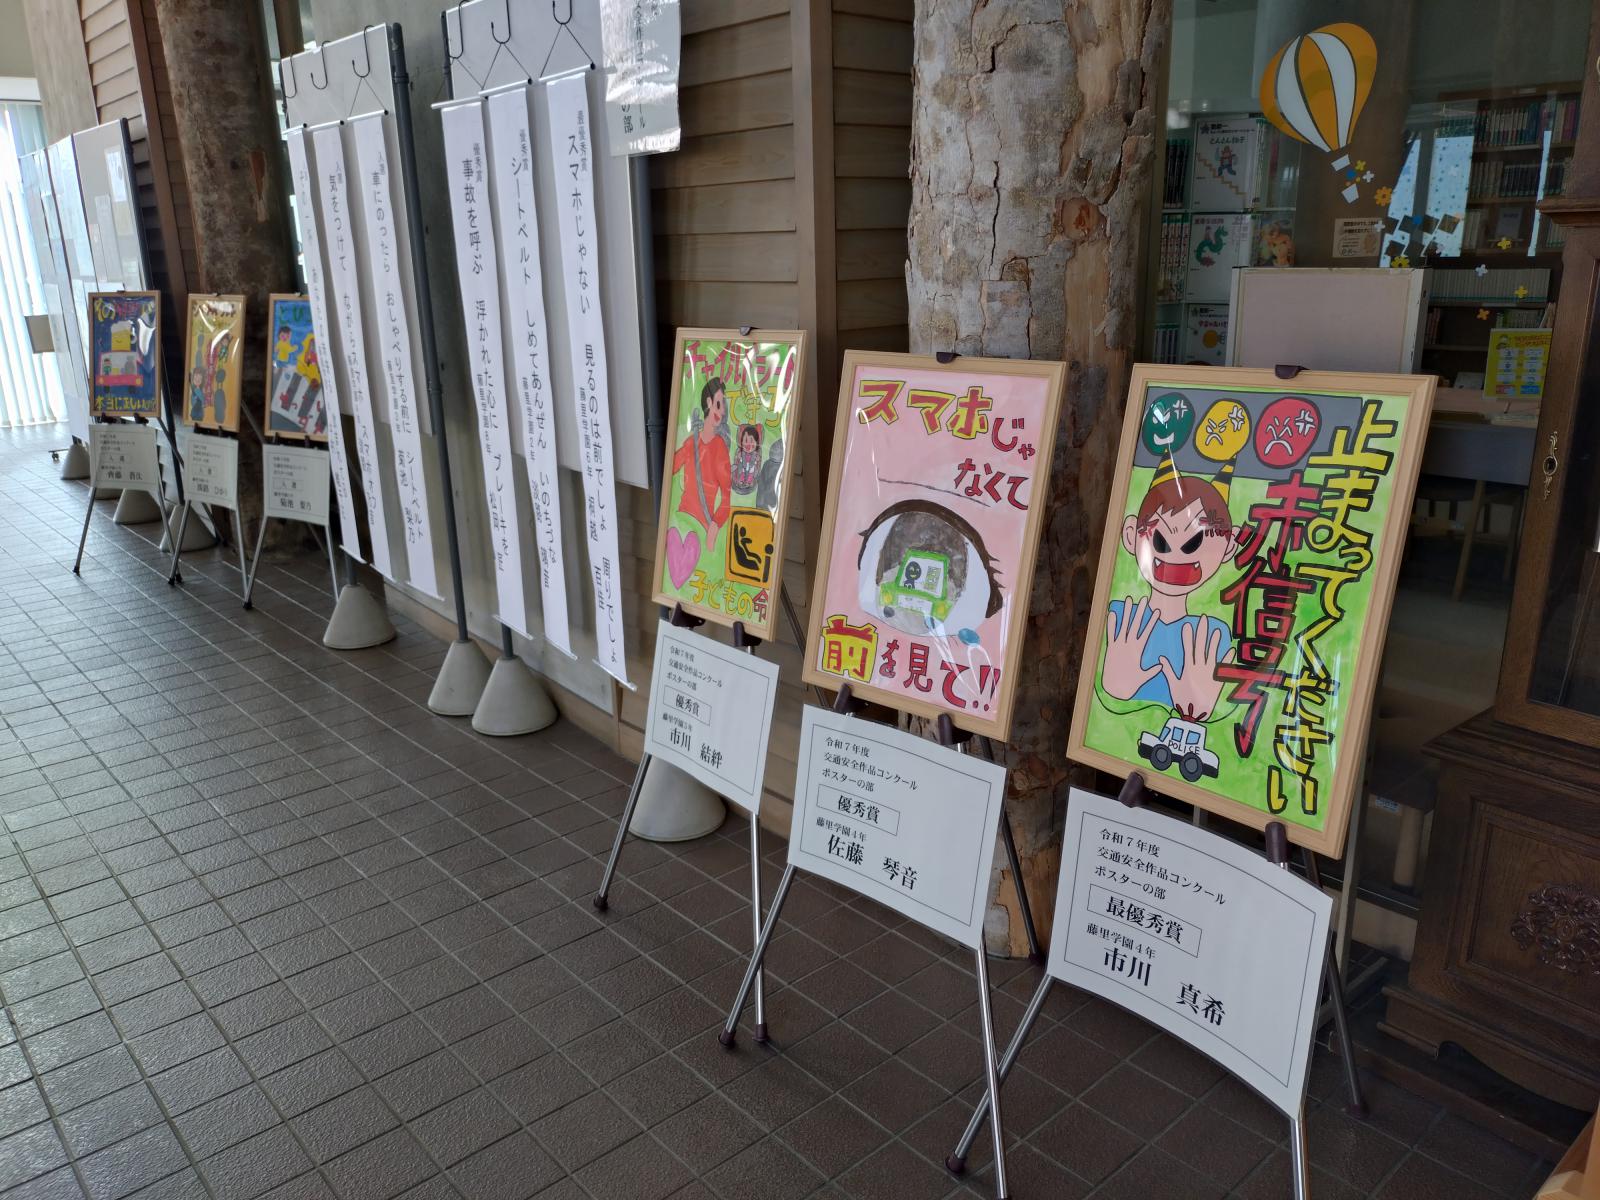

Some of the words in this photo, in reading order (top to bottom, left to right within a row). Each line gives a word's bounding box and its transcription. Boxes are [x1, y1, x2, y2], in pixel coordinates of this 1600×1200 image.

[371, 170, 391, 273] 車にのったら
[461, 159, 484, 275] 事故を呼ぶ
[568, 134, 591, 315] スマホじゃない
[511, 156, 532, 287] シートベルト
[526, 308, 547, 450] しめてあんぜん
[858, 379, 1036, 461] スマホじゃ
[953, 457, 1030, 511] なくて
[689, 568, 769, 624] 子どもの命
[1212, 468, 1322, 758] 赤信号
[1267, 398, 1399, 815] 止まってください
[675, 693, 700, 717] 優秀賞
[670, 727, 692, 752] 市川
[825, 736, 871, 758] 令和7年度
[1168, 739, 1201, 756] POLICE
[821, 767, 874, 793] ポスターの部
[823, 751, 918, 791] 交通安全作品コンクール
[837, 794, 881, 825] 優秀賞
[827, 833, 865, 867] 佐藤
[882, 856, 918, 891] 琴音
[1099, 828, 1161, 859] 令和7年度
[1094, 864, 1167, 901] ポスターの部
[1096, 845, 1227, 906] 交通安全作品コンクール
[1085, 922, 1157, 960] 藤里学園4年
[1105, 895, 1186, 945] 最優秀賞
[1103, 946, 1153, 987] 市川
[1176, 981, 1227, 1026] 真希
